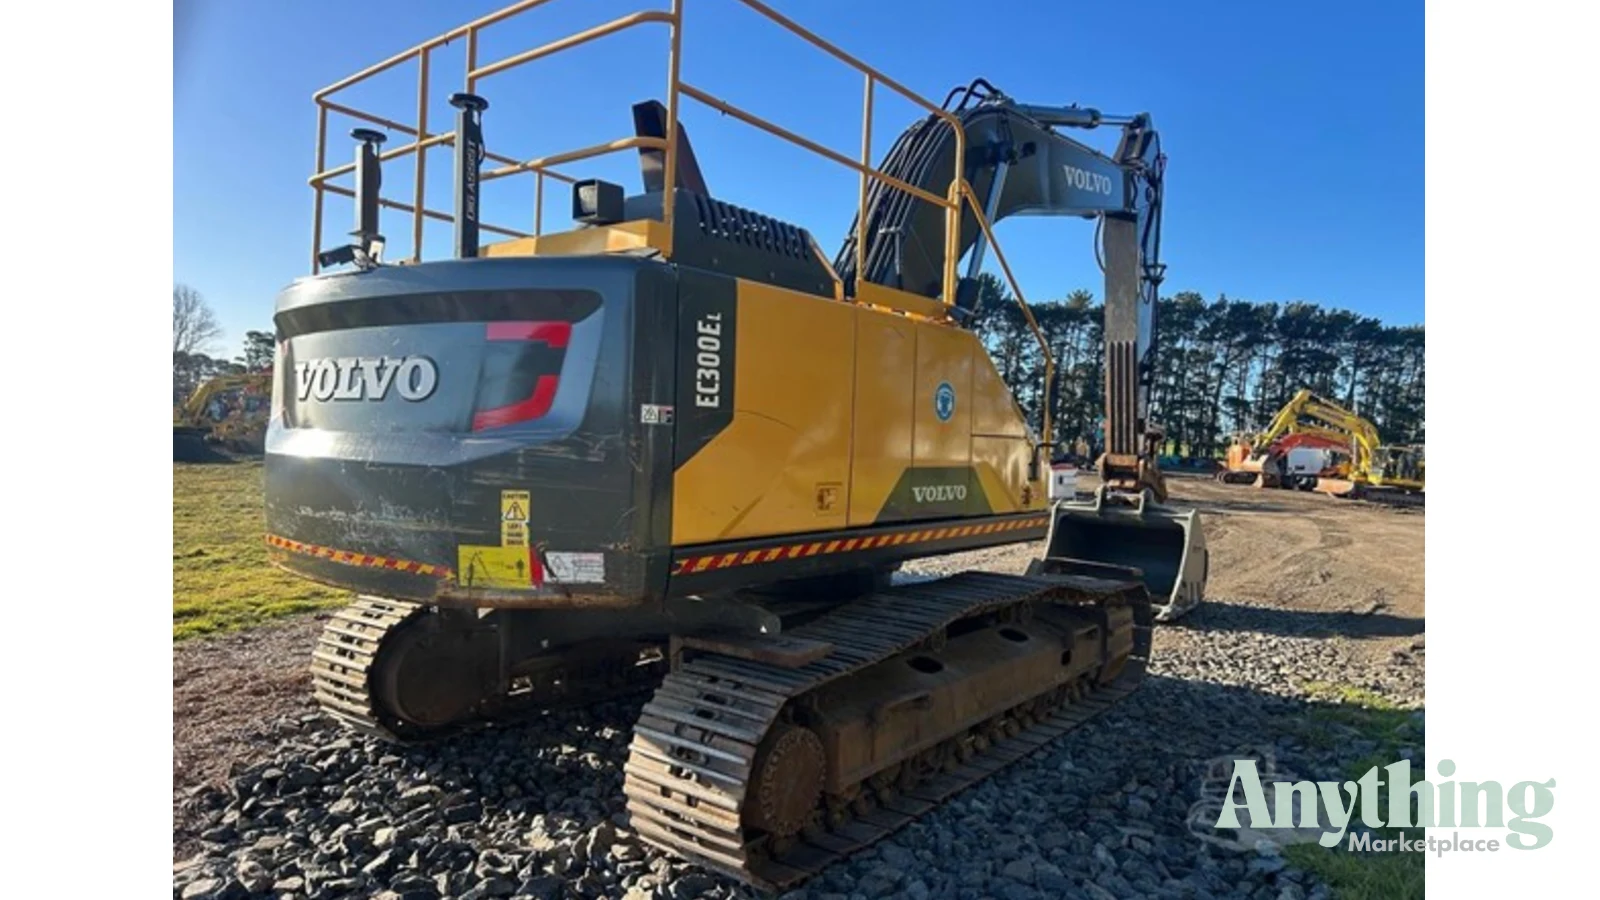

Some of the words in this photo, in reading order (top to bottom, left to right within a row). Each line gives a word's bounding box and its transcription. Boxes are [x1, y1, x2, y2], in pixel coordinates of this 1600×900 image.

[1063, 164, 1112, 195] VOLVO
[295, 356, 439, 403] VOLVO
[912, 484, 967, 503] VOLVO
